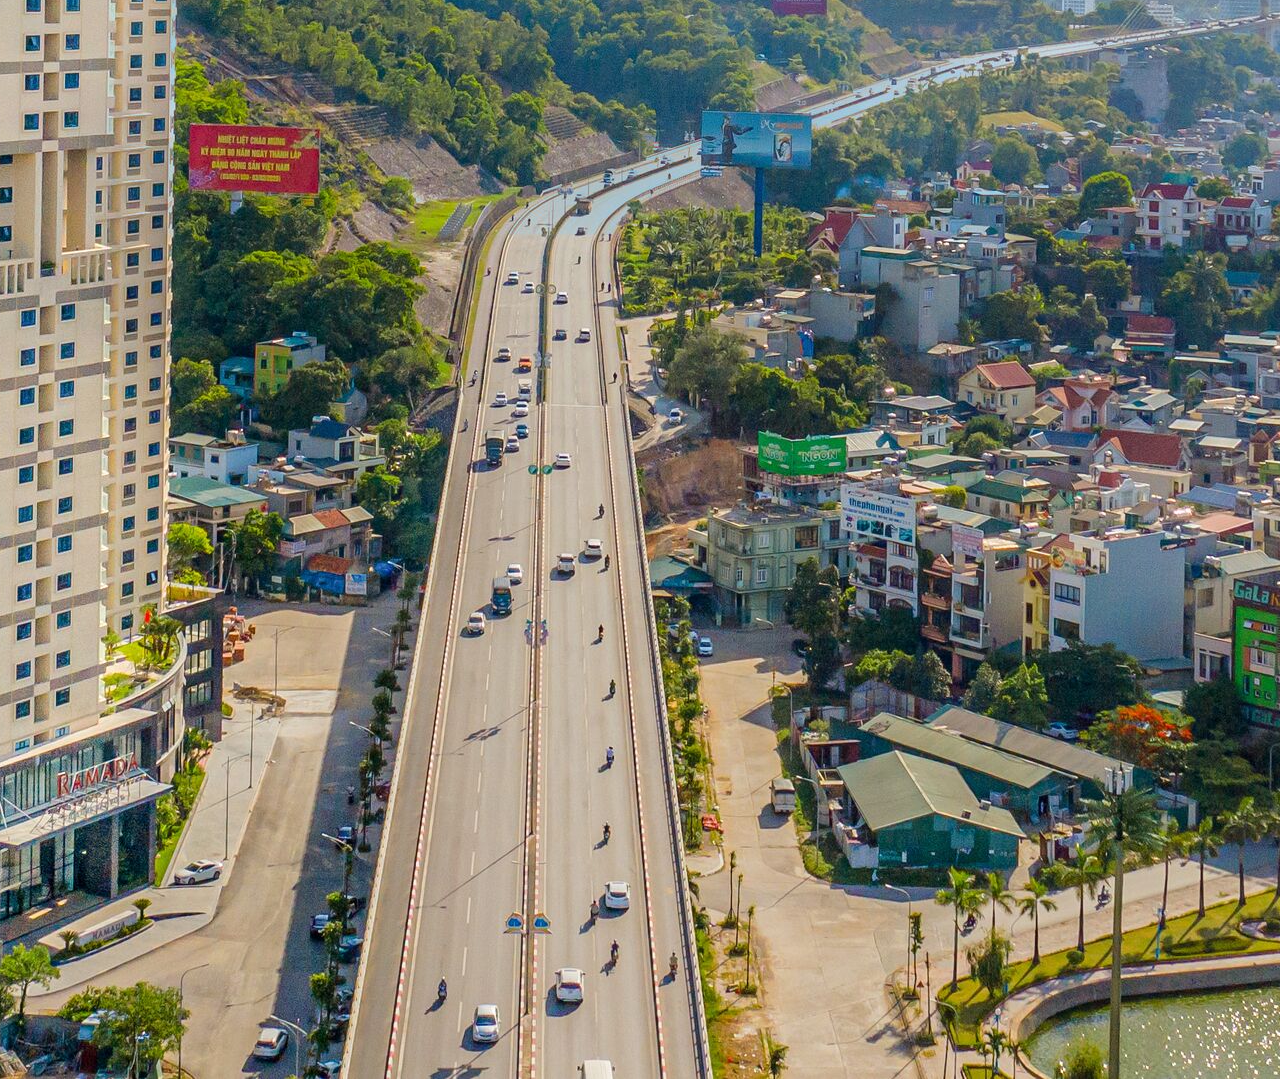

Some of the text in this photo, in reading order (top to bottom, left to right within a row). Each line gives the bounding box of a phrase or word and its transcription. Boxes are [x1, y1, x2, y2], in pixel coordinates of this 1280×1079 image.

[237, 136, 249, 145] LIỆT
[262, 162, 275, 172] VIỆT
[276, 164, 290, 172] NAM
[57, 753, 138, 798] RAMADA
